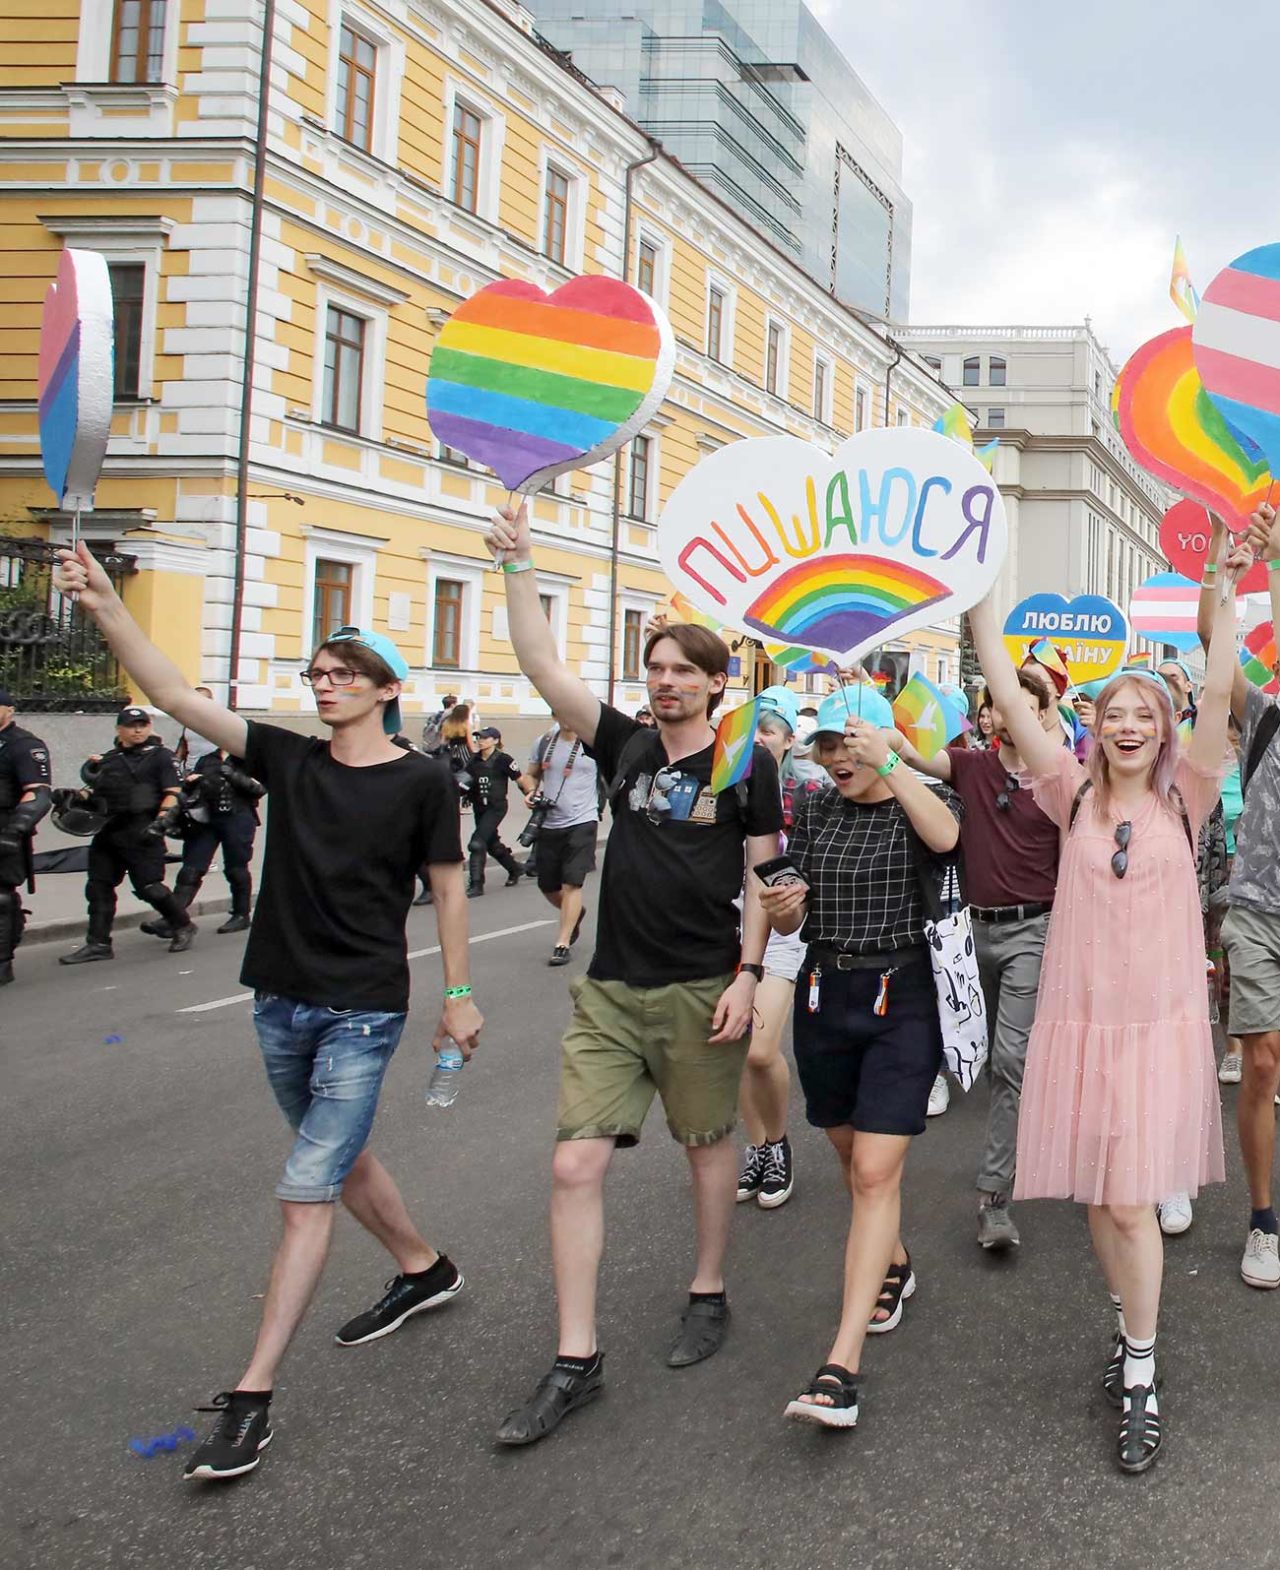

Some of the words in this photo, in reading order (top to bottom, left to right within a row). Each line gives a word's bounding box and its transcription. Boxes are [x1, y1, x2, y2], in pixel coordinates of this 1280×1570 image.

[1177, 532, 1211, 553] YO
[1021, 611, 1112, 634] ЛЮБЛЮ
[1021, 642, 1113, 665] УАЇНУ
